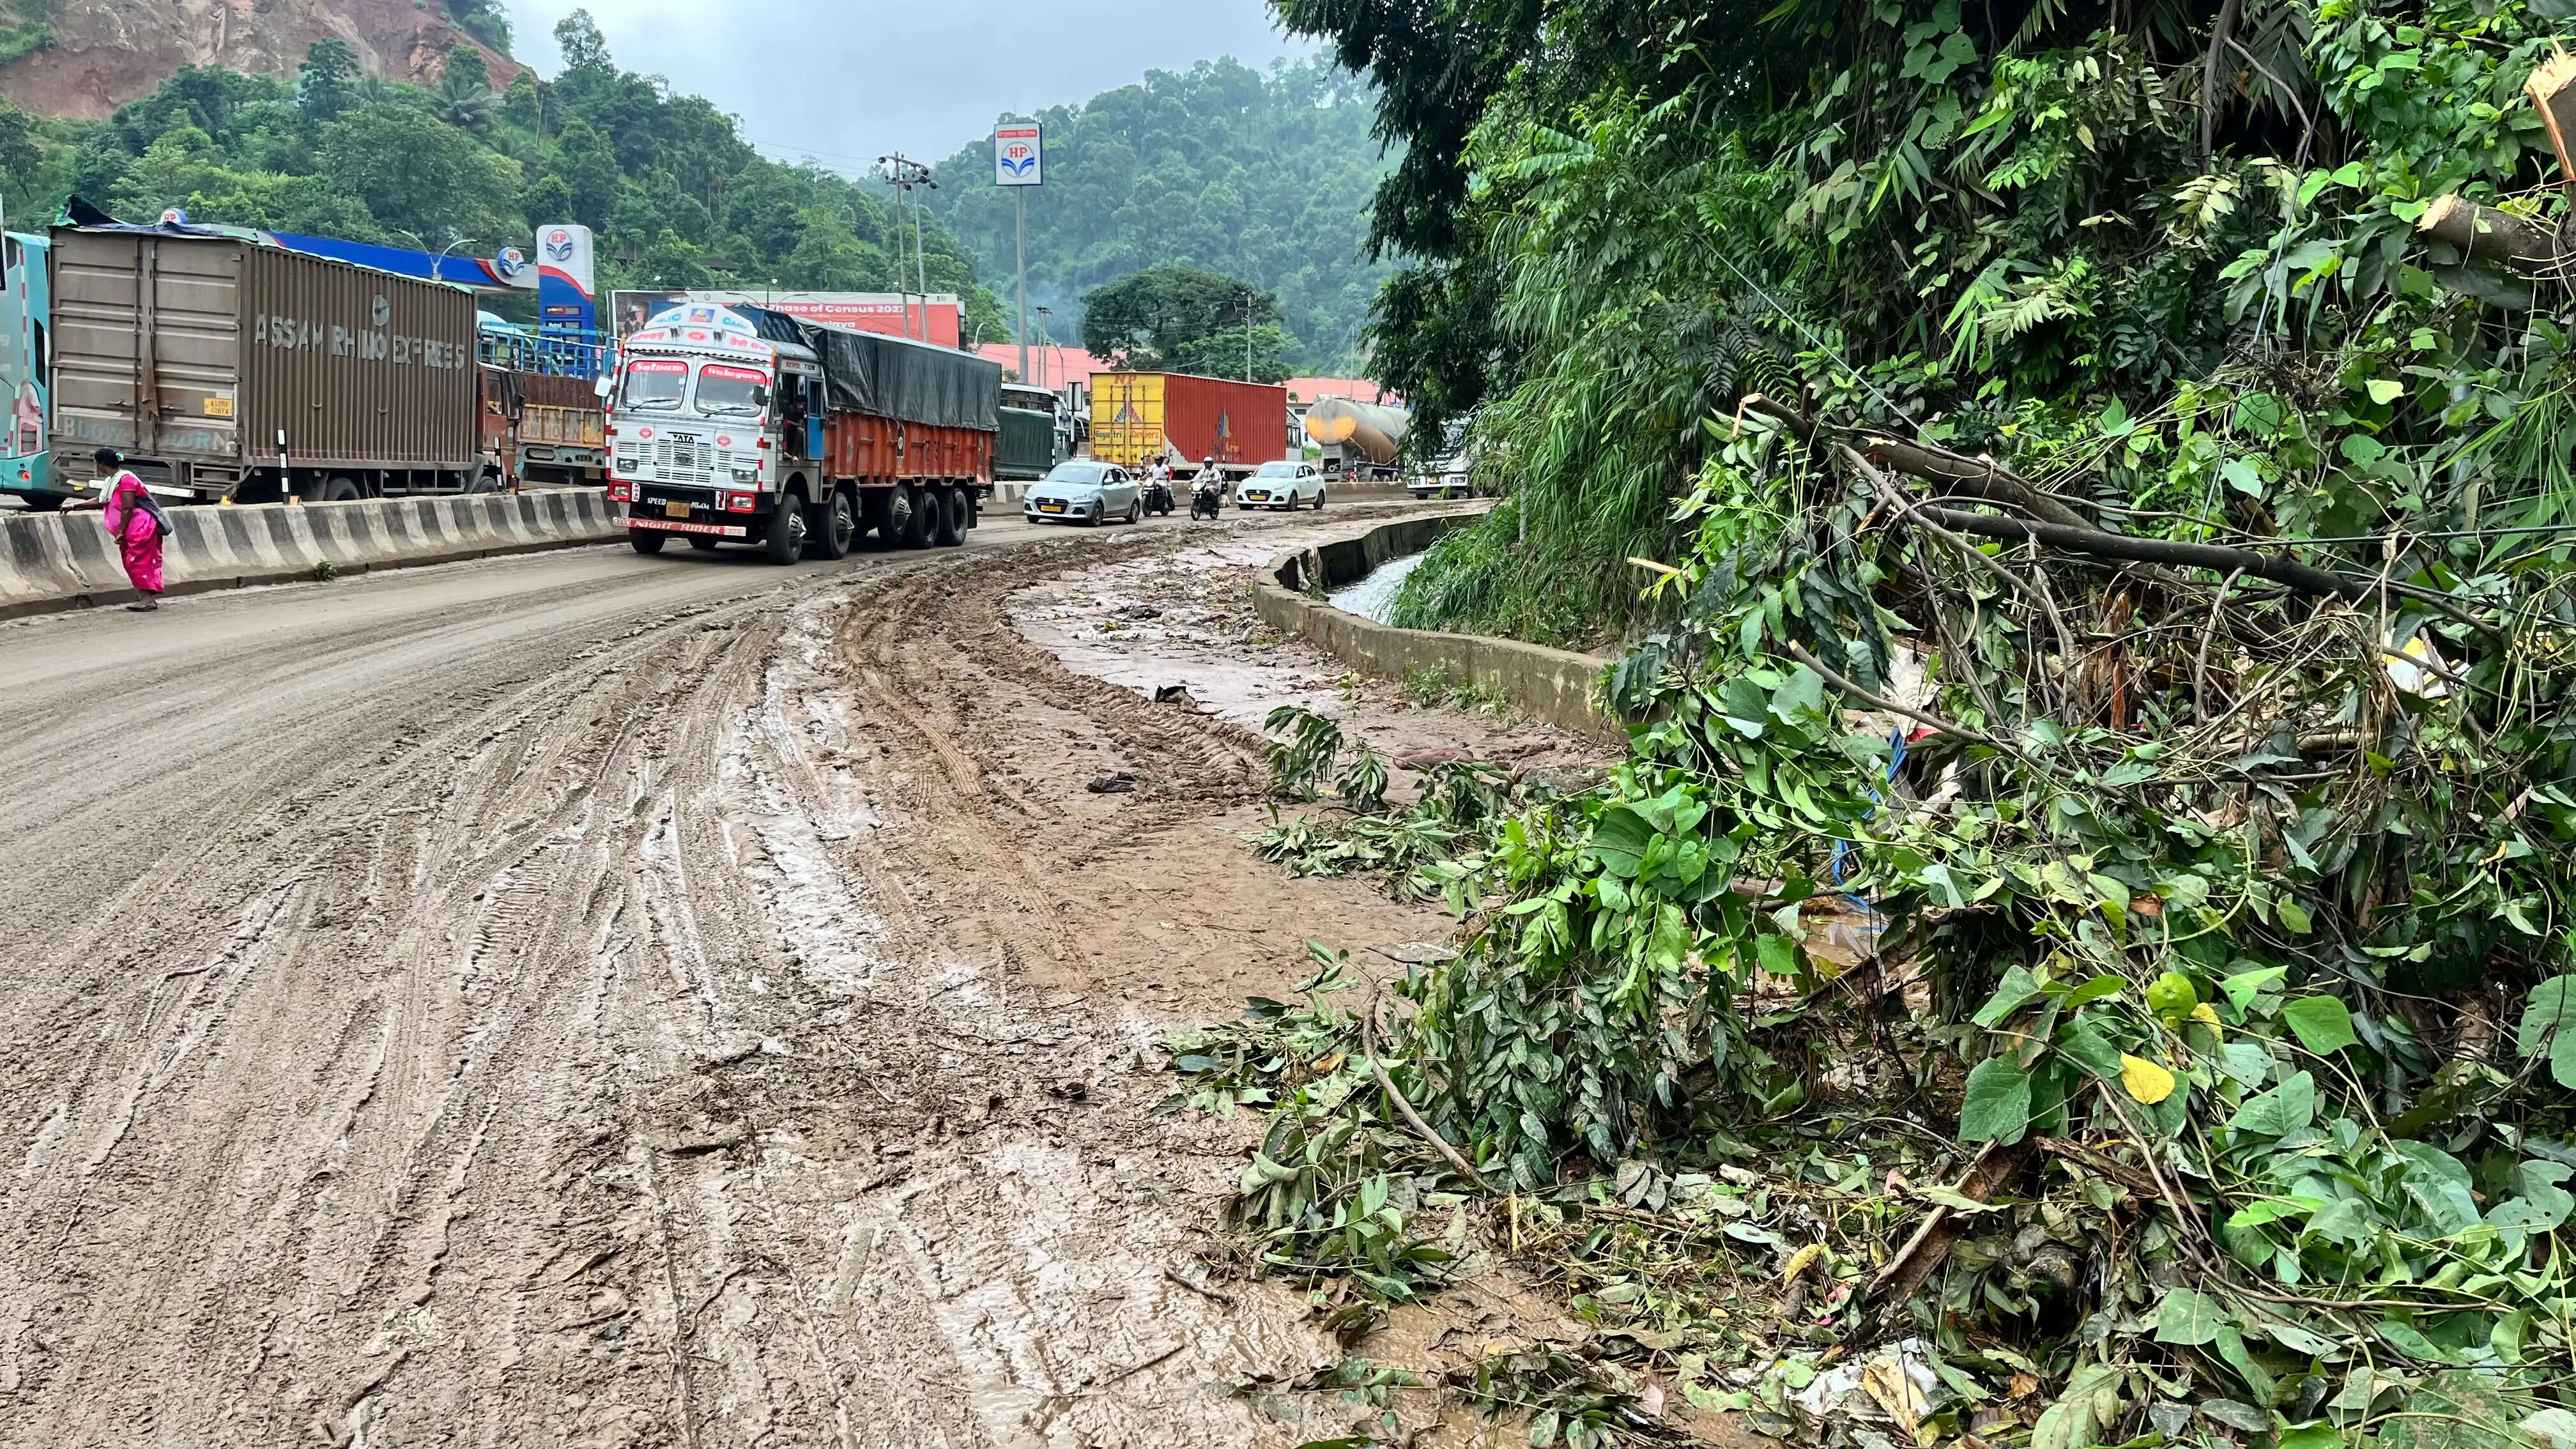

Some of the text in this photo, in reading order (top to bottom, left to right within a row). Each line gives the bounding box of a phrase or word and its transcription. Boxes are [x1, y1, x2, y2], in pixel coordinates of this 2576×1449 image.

[1009, 147, 1028, 158] HP
[551, 233, 567, 243] HP
[508, 252, 520, 261] HP
[1114, 374, 1137, 384] NP
[673, 434, 694, 444] TATA
[647, 497, 667, 506] SPEED
[679, 523, 721, 534] RIDER
